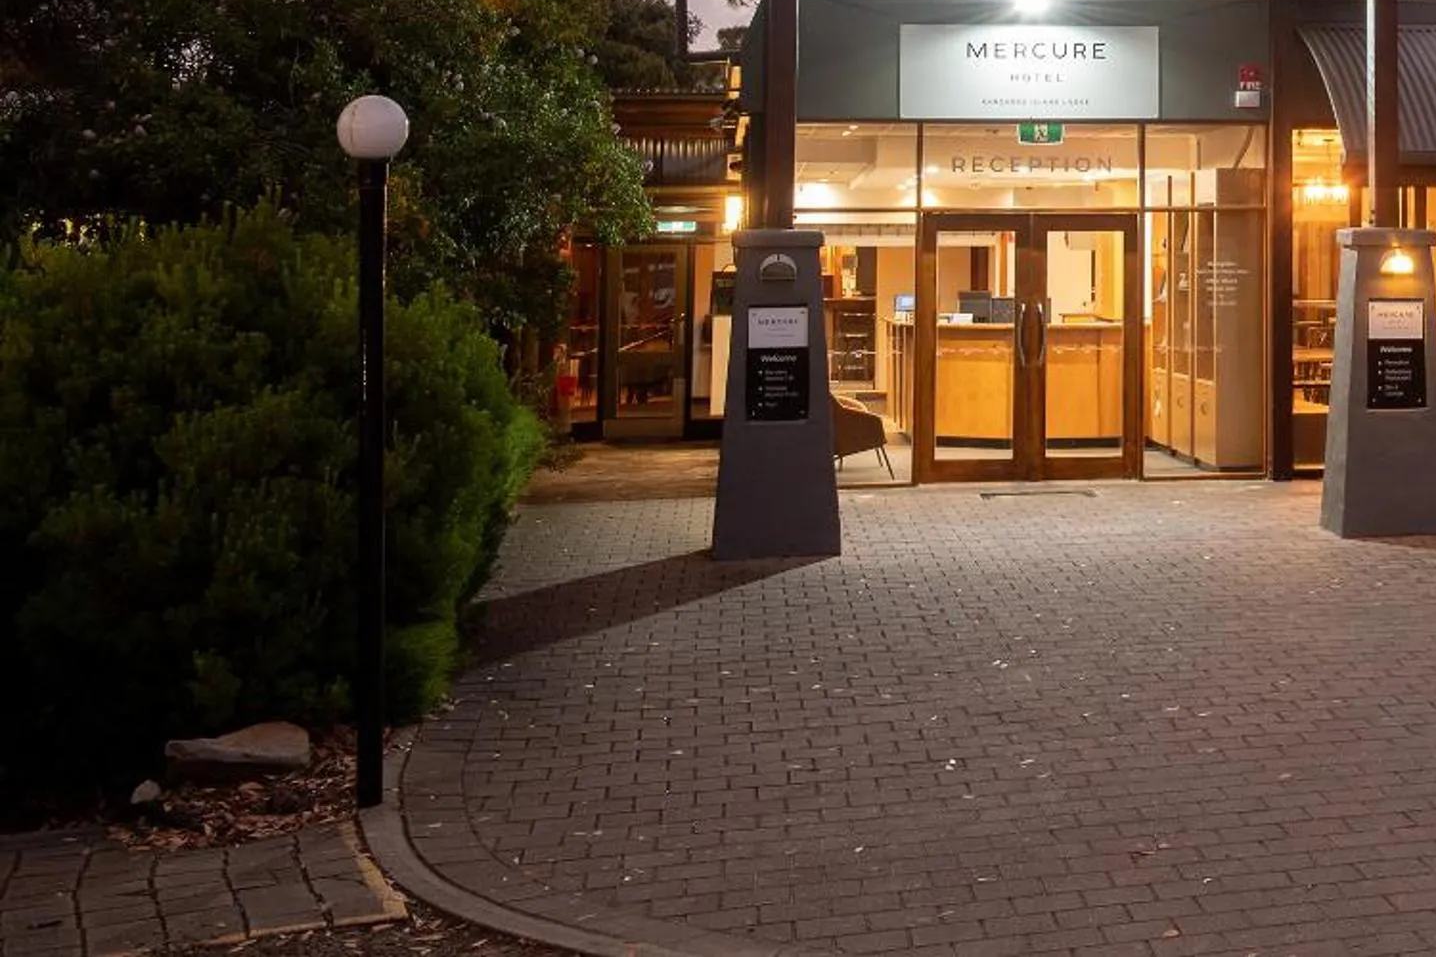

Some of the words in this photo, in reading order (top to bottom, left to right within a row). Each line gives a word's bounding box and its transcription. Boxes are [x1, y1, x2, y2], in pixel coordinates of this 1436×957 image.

[966, 42, 1107, 60] MERCURE
[1010, 73, 1065, 83] HOTEL
[951, 156, 1113, 173] RECEPTION
